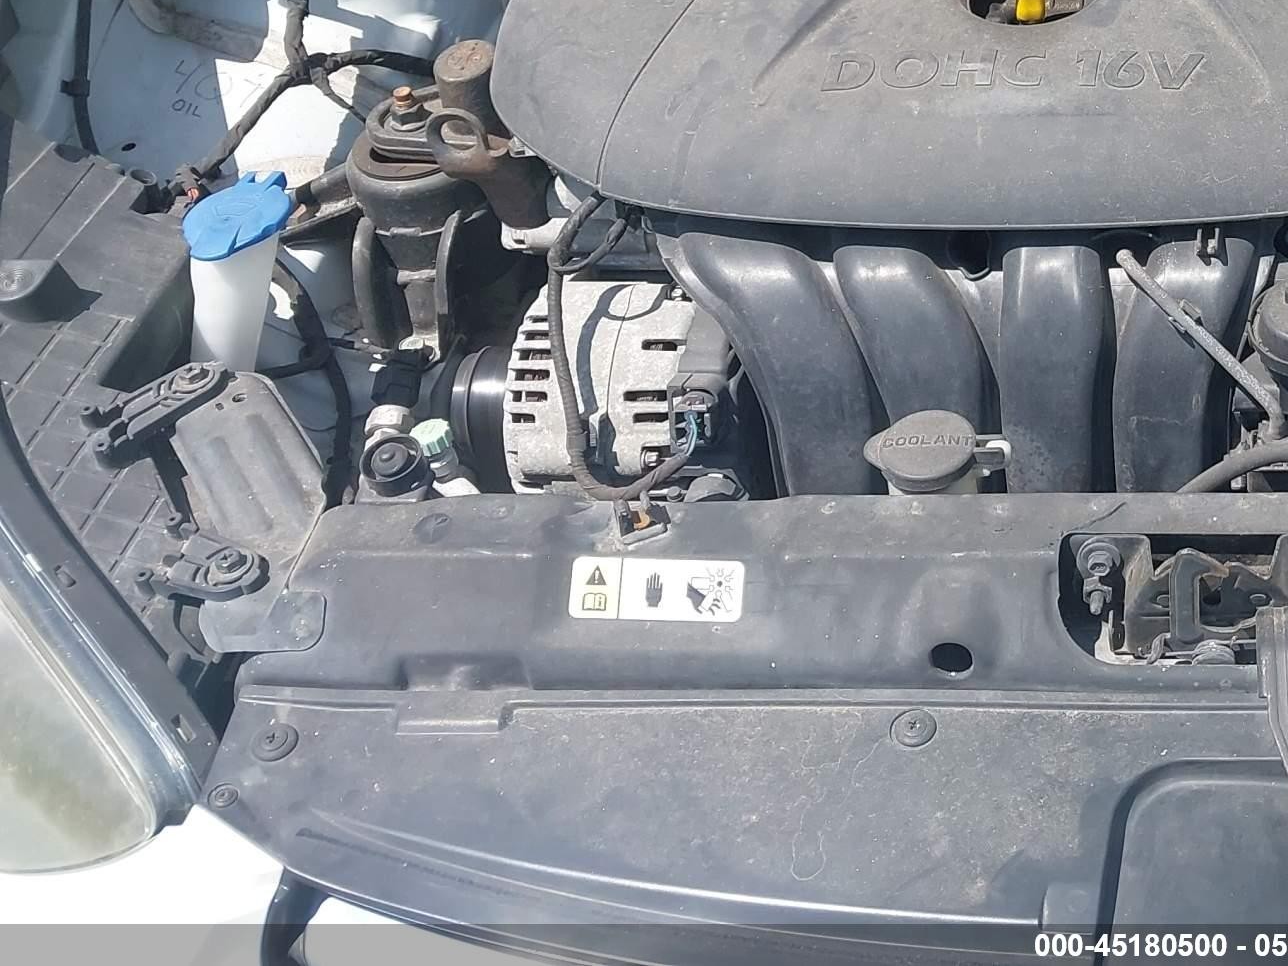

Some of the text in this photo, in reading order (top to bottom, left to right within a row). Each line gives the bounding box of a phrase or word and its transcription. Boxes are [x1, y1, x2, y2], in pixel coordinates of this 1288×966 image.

[820, 49, 1206, 92] DOHC 16V
[171, 98, 201, 118] OIL
[882, 434, 974, 449] COOLANT
